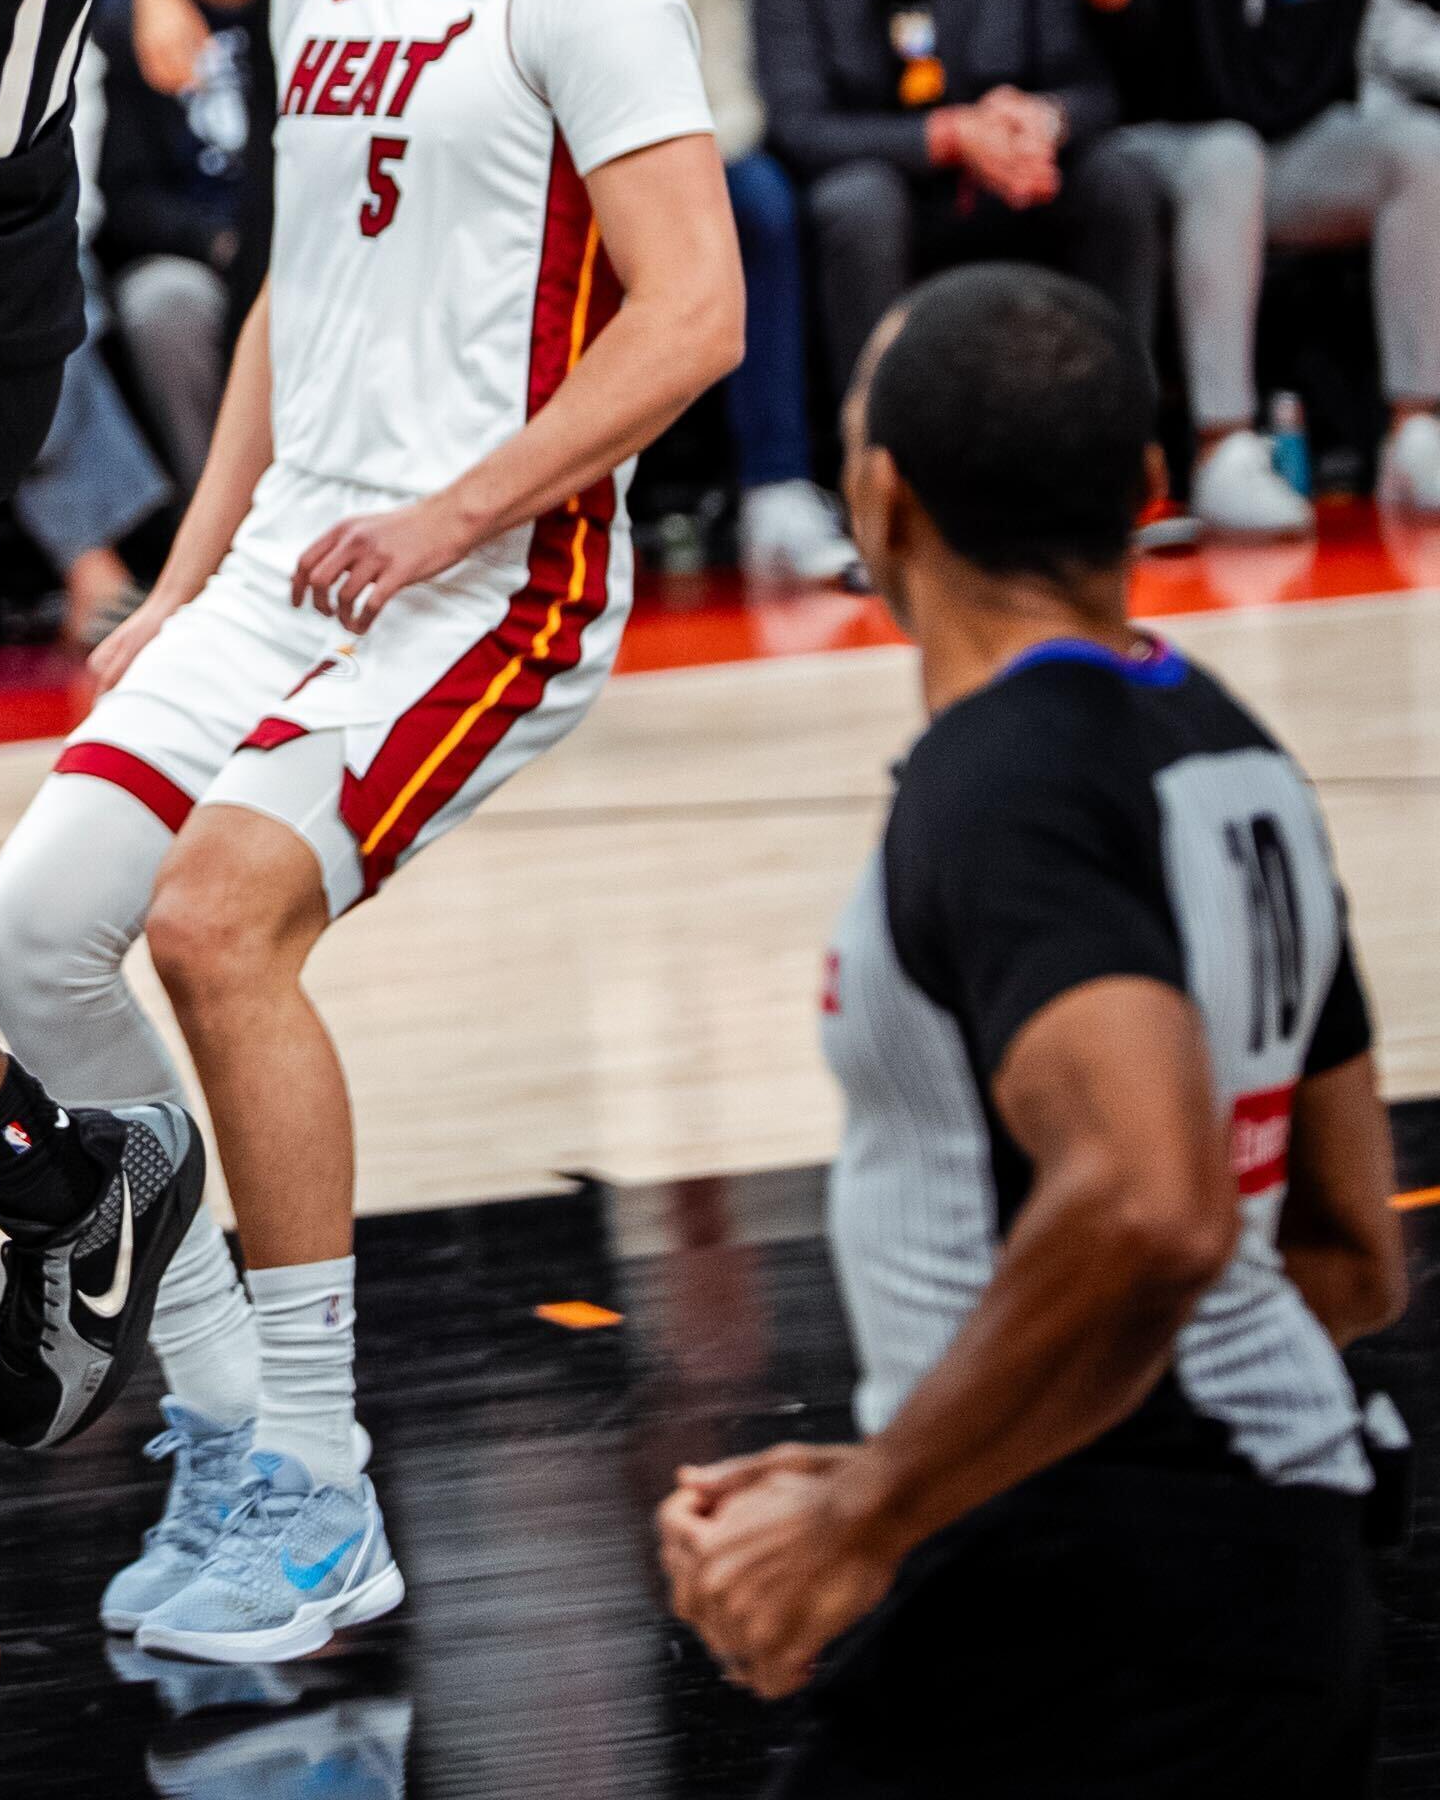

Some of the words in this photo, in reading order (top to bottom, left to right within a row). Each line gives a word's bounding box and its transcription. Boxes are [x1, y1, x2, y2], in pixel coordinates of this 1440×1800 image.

[281, 10, 474, 117] HEAT
[359, 136, 410, 238] 5
[1222, 812, 1306, 1056] 10
